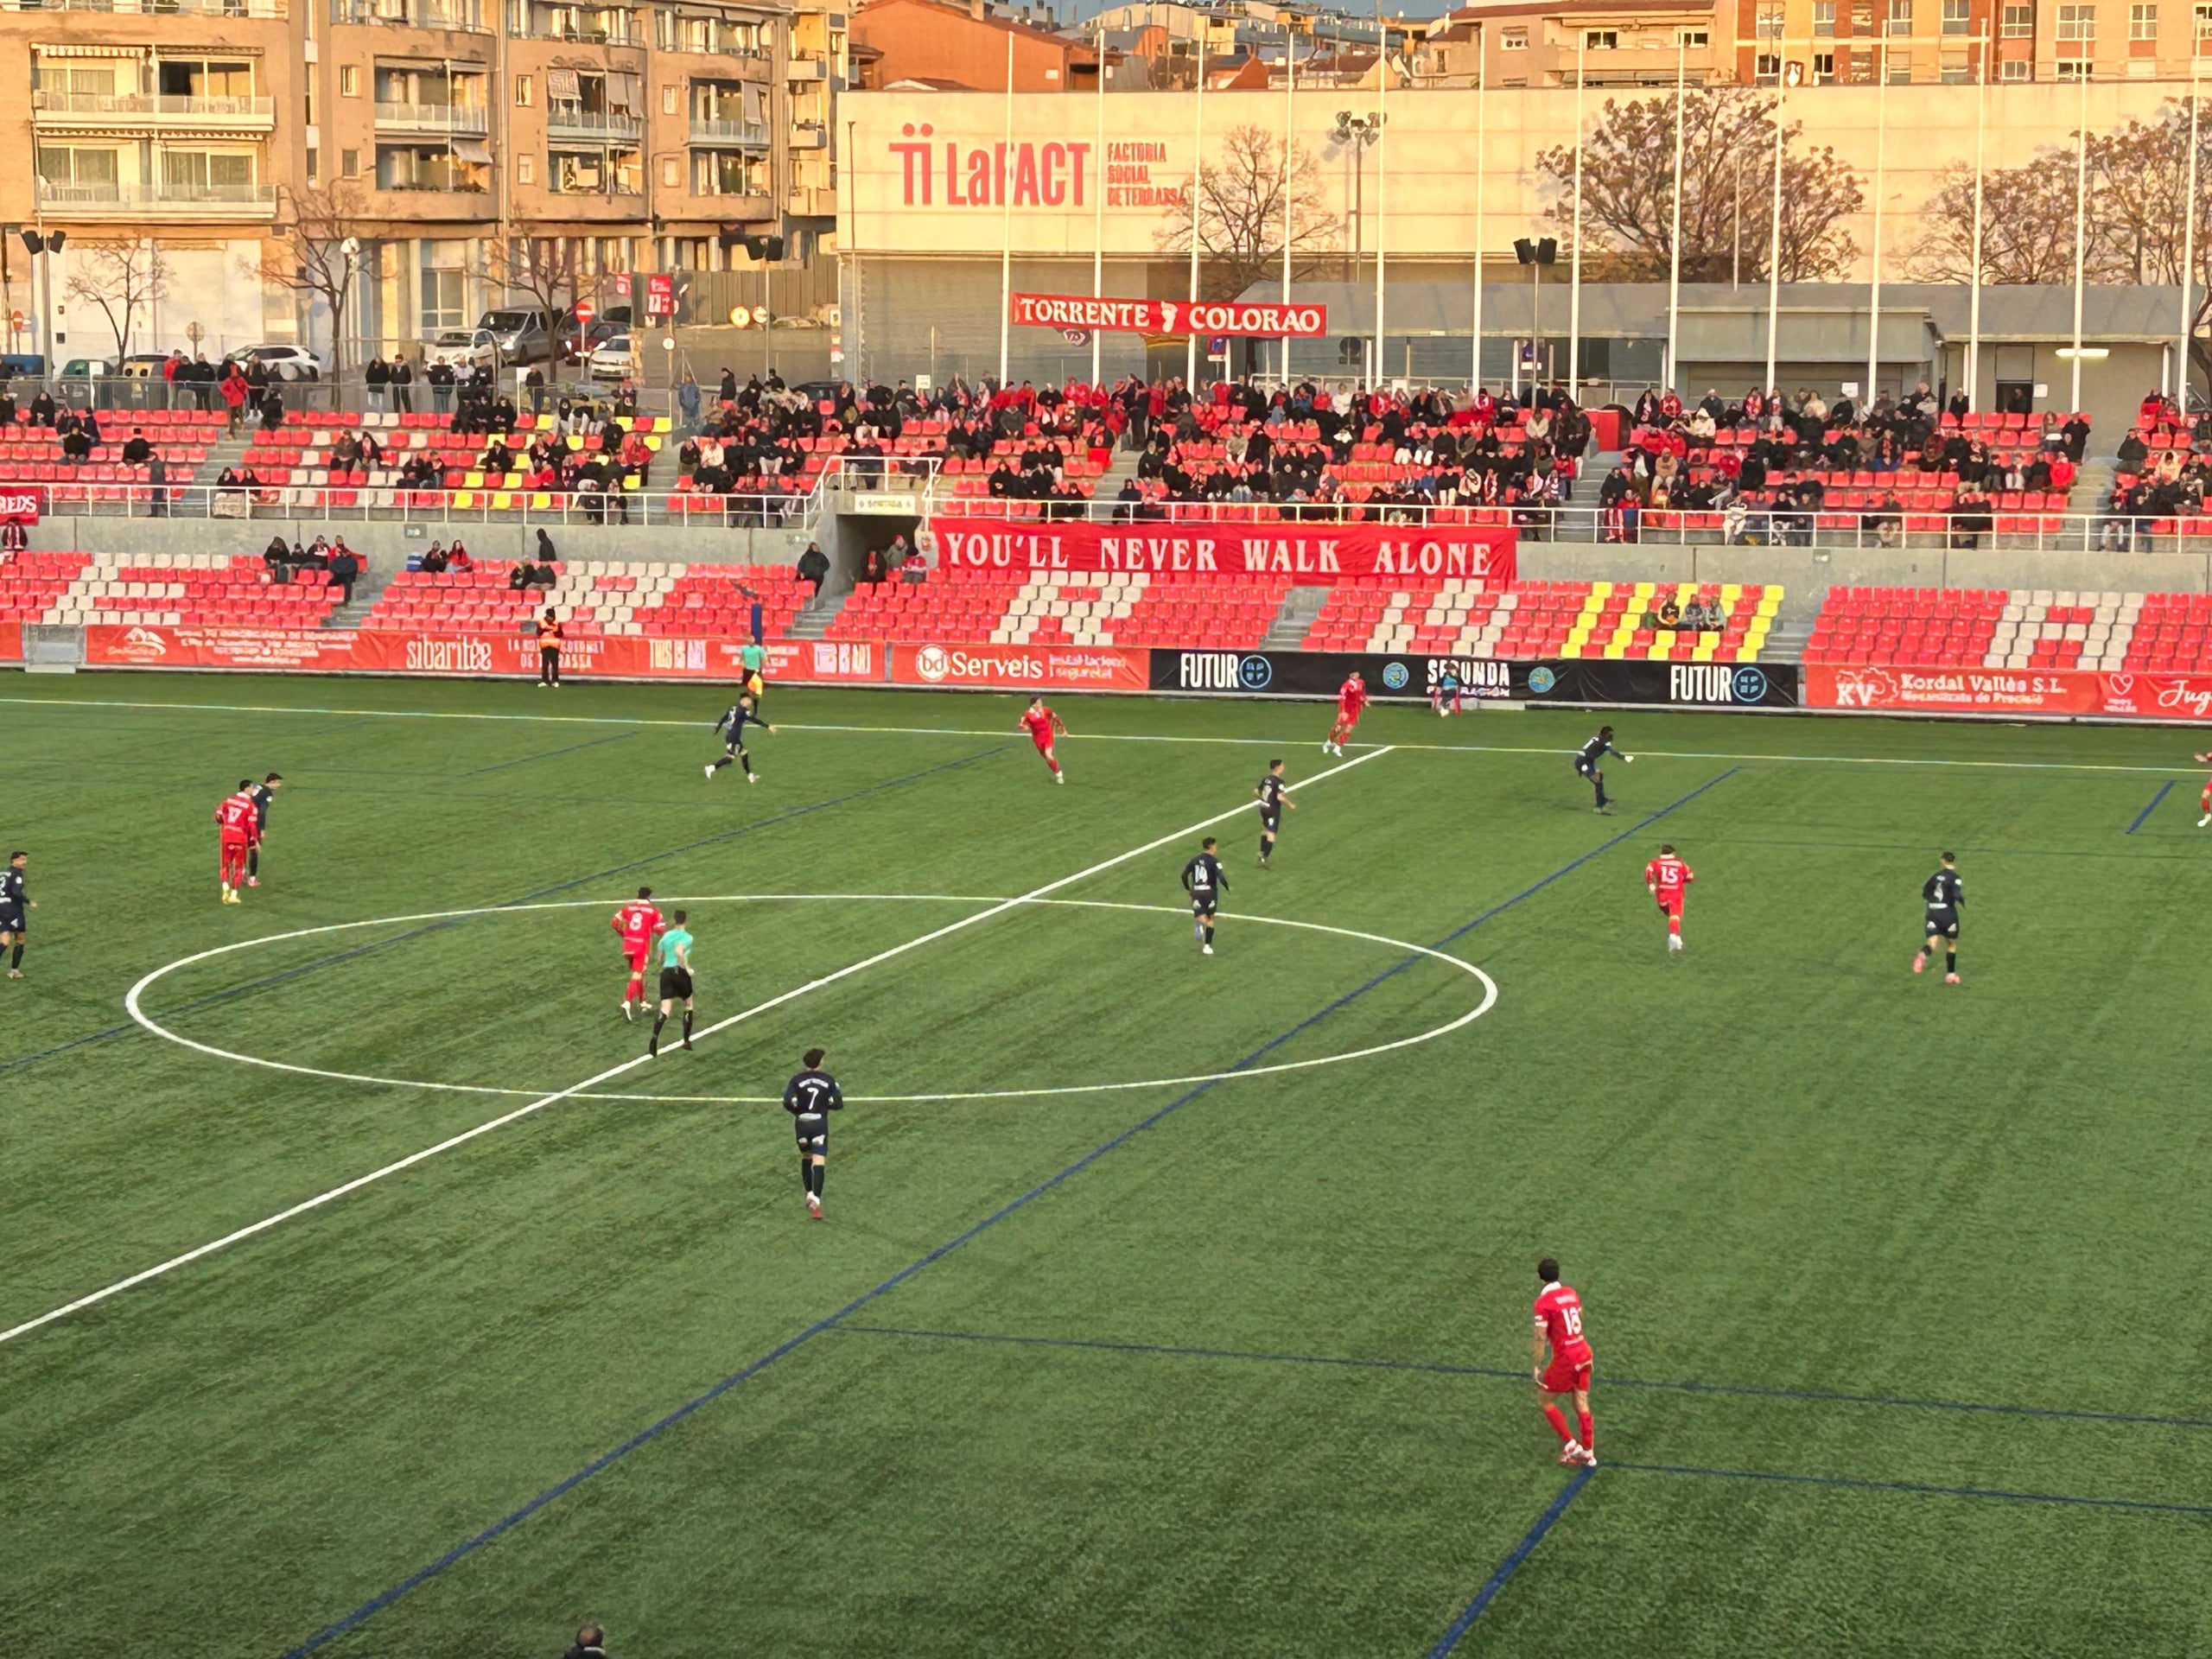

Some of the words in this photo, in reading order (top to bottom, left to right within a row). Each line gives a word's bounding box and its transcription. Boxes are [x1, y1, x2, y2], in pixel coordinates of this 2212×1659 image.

[947, 142, 1090, 207] LaFACT
[1020, 299, 1150, 327] TORRENTE
[1188, 306, 1321, 332] COLORAO
[944, 531, 1069, 569] YOU'LL
[1100, 537, 1217, 572] NEVER
[1242, 539, 1341, 573] WALK
[1372, 541, 1492, 575] ALONE
[951, 652, 1043, 678] Serveis
[1180, 653, 1240, 689] FUTUR
[1670, 664, 1732, 702] FUTUR
[1836, 683, 1876, 706] KV
[1901, 673, 1965, 690] Kordal
[1661, 866, 1679, 884] 15
[629, 912, 643, 931] 8
[807, 1087, 819, 1110] 7
